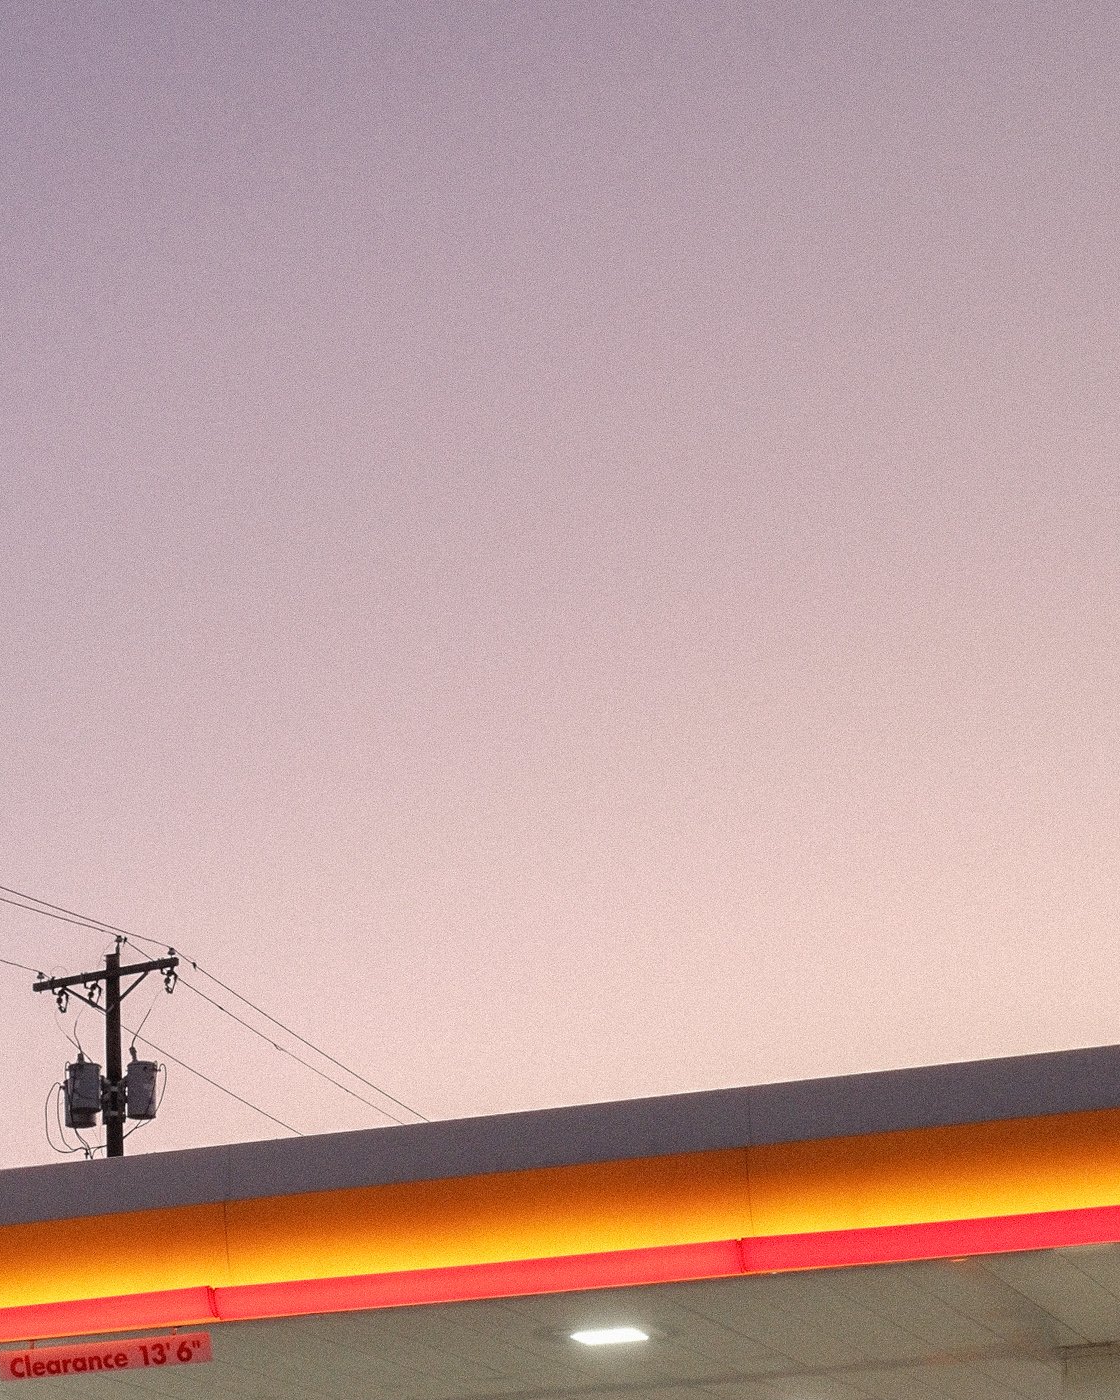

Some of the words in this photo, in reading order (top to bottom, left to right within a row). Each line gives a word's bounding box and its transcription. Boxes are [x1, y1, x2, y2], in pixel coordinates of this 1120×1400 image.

[9, 1352, 128, 1378] Clearance
[139, 1342, 171, 1366] 13'
[176, 1340, 200, 1362] 6"
